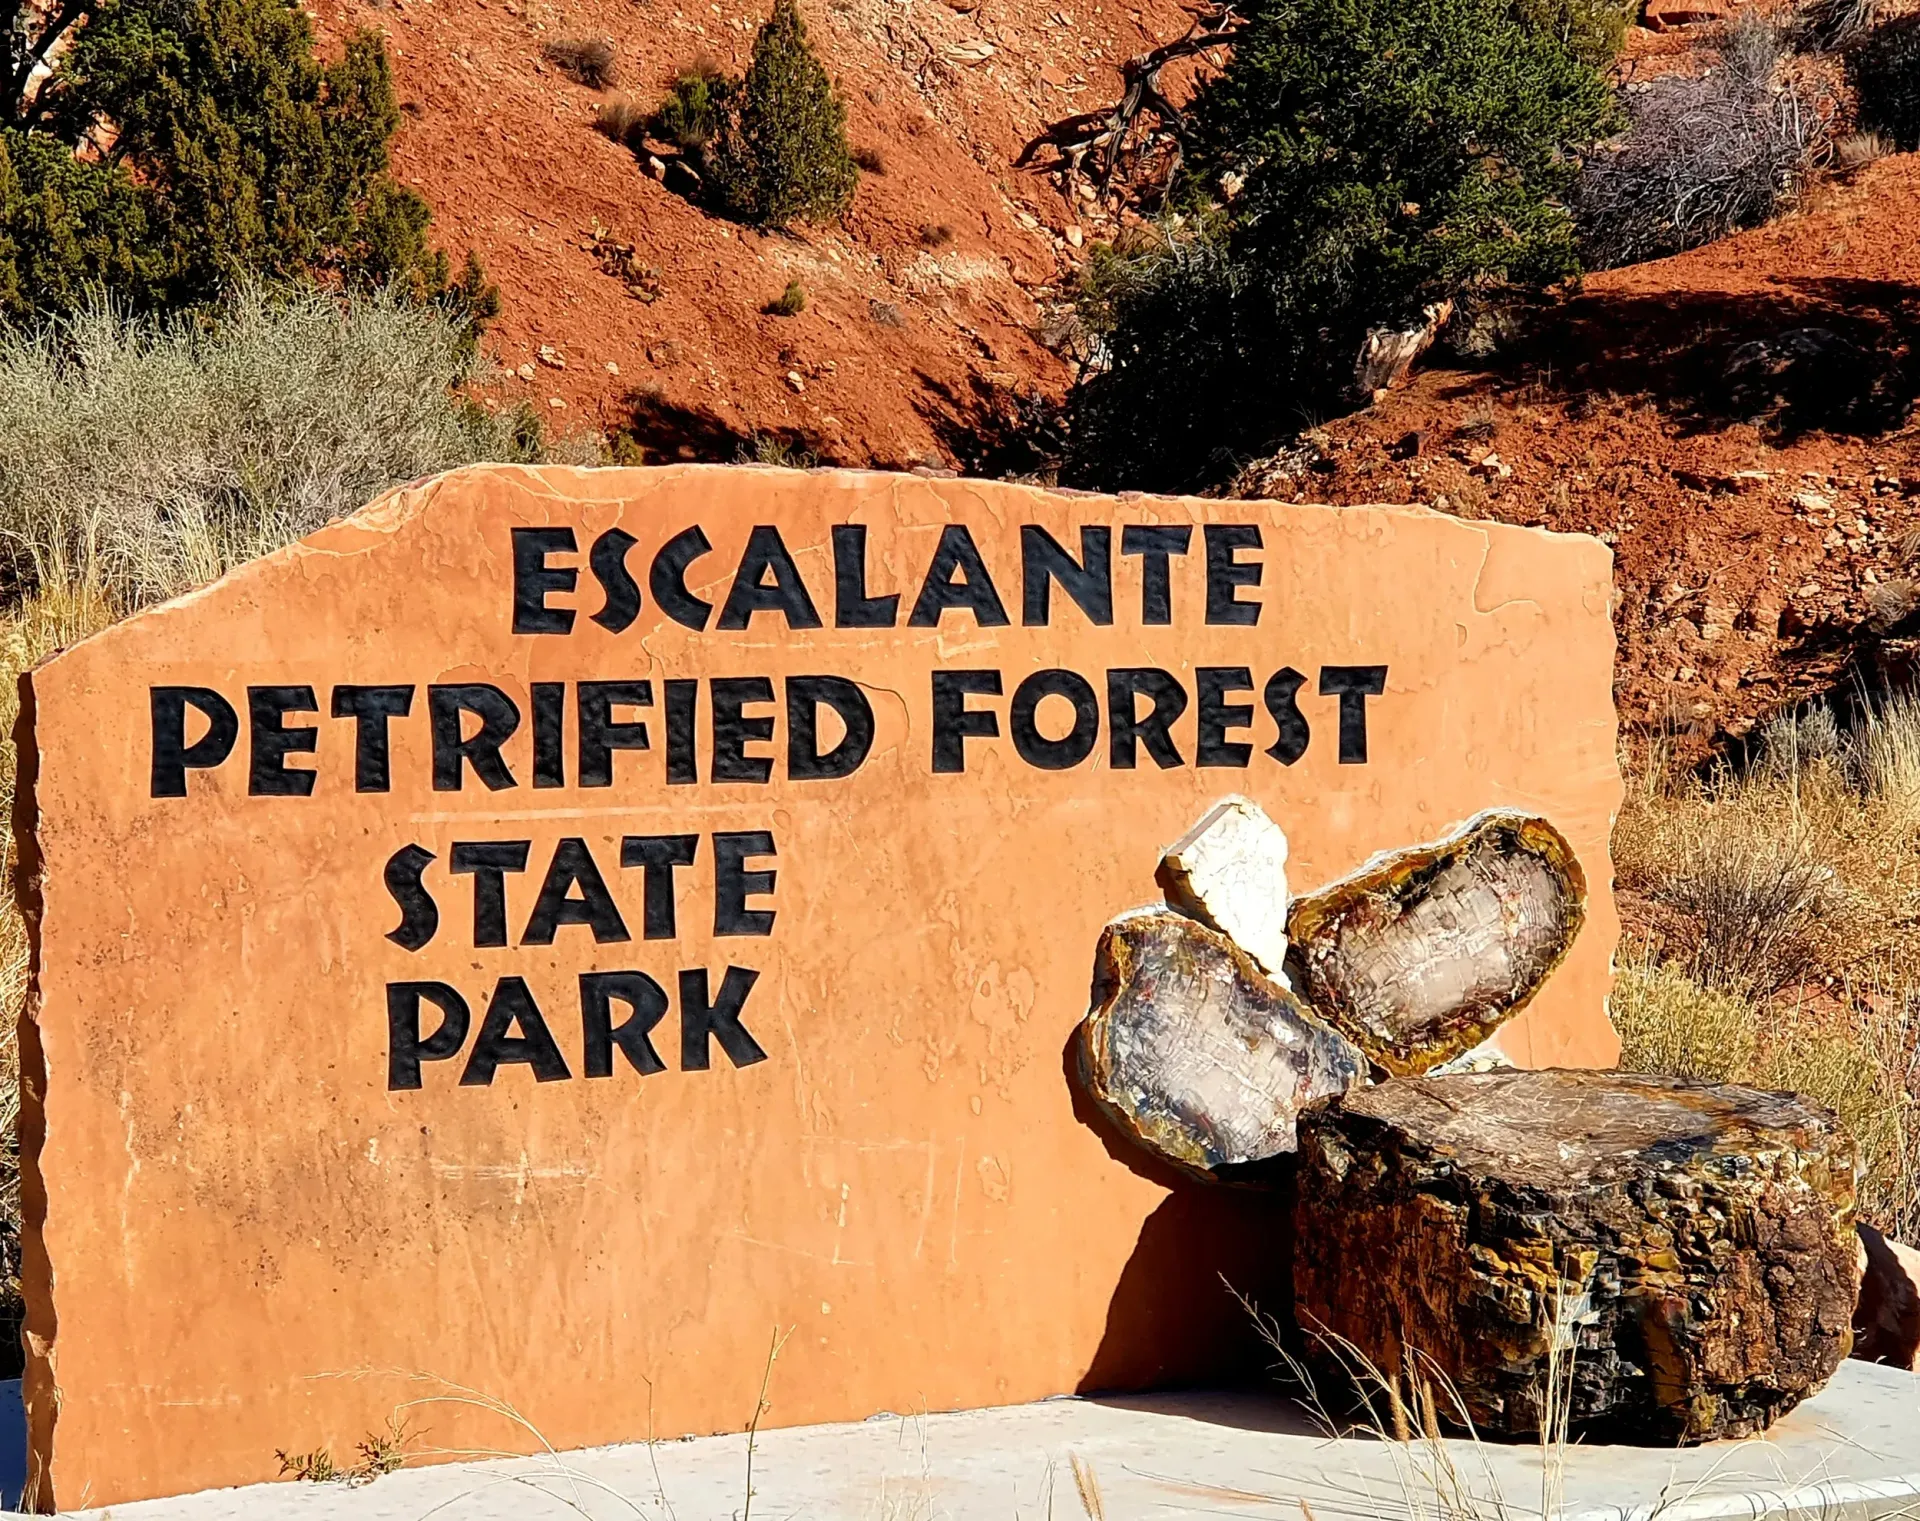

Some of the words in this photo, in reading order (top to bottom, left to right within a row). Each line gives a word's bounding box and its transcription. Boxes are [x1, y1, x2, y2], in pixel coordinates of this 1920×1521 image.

[510, 520, 1265, 636] ESCALANTE
[149, 674, 875, 799] PETRIFIED
[931, 664, 1389, 774] FOREST
[383, 830, 778, 953] STATE
[385, 965, 768, 1092] PARK
